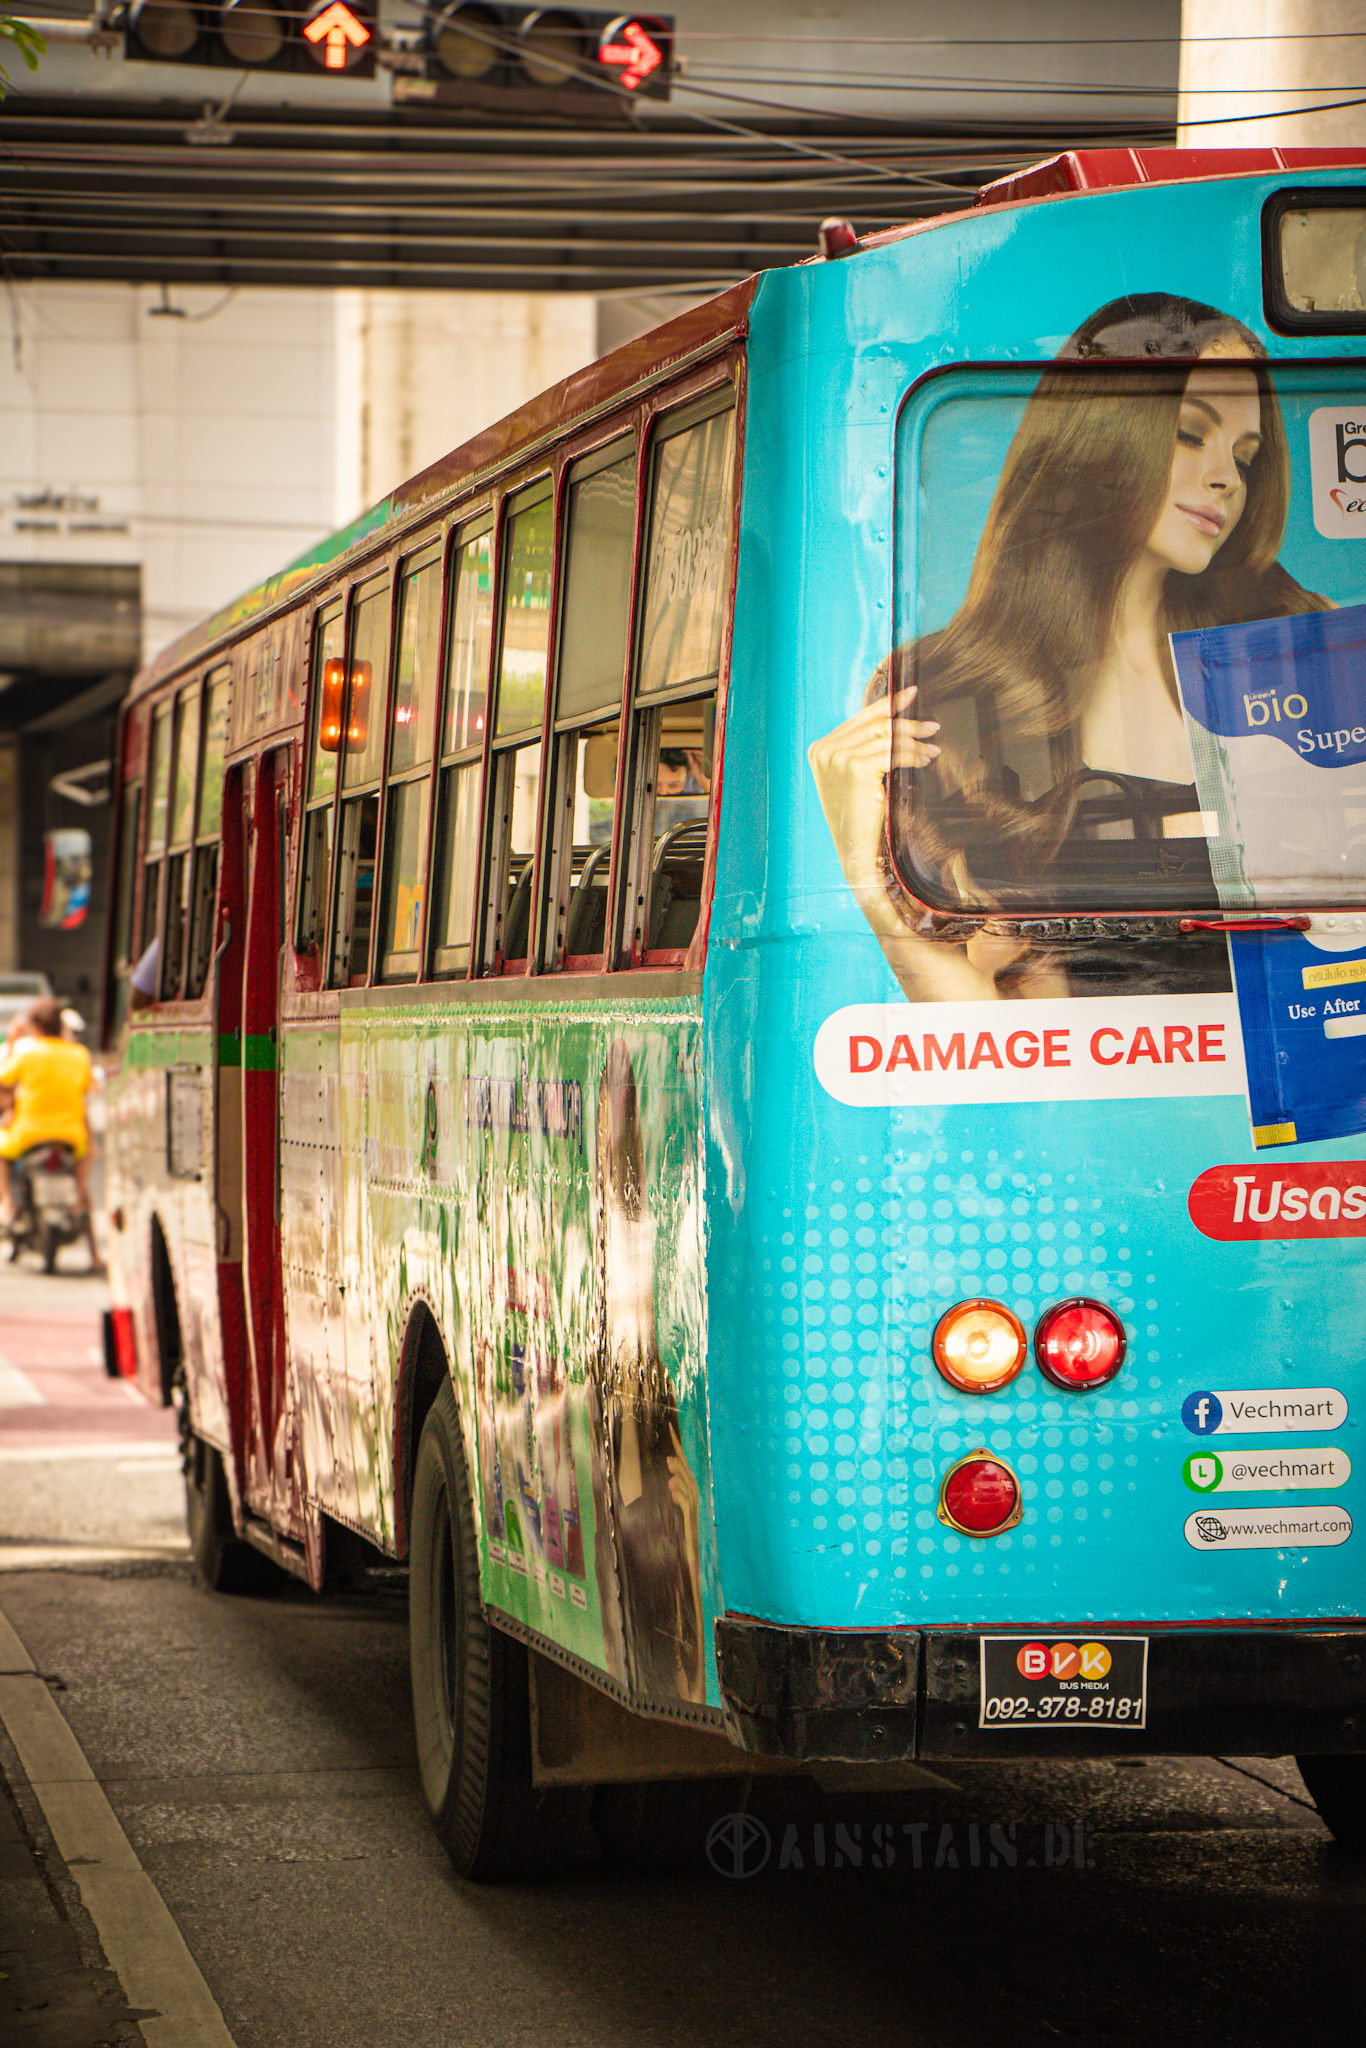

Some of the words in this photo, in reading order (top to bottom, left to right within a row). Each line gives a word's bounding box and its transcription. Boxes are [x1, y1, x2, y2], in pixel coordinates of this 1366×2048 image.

[1243, 689, 1308, 727] bio
[1297, 726, 1366, 754] Supe
[1288, 1004, 1317, 1020] Use
[1323, 998, 1361, 1015] After
[848, 1029, 1071, 1074] DAMAGE
[1089, 1023, 1227, 1066] CARE
[1230, 1400, 1334, 1419] Vechmart
[1231, 1460, 1335, 1481] @vechmart
[1220, 1520, 1351, 1536] www.vechmart.com
[1025, 1650, 1106, 1674] BVK
[1059, 1682, 1079, 1690] BUS
[1081, 1682, 1110, 1690] MEDIA
[985, 1696, 1143, 1720] 092-378-8181
